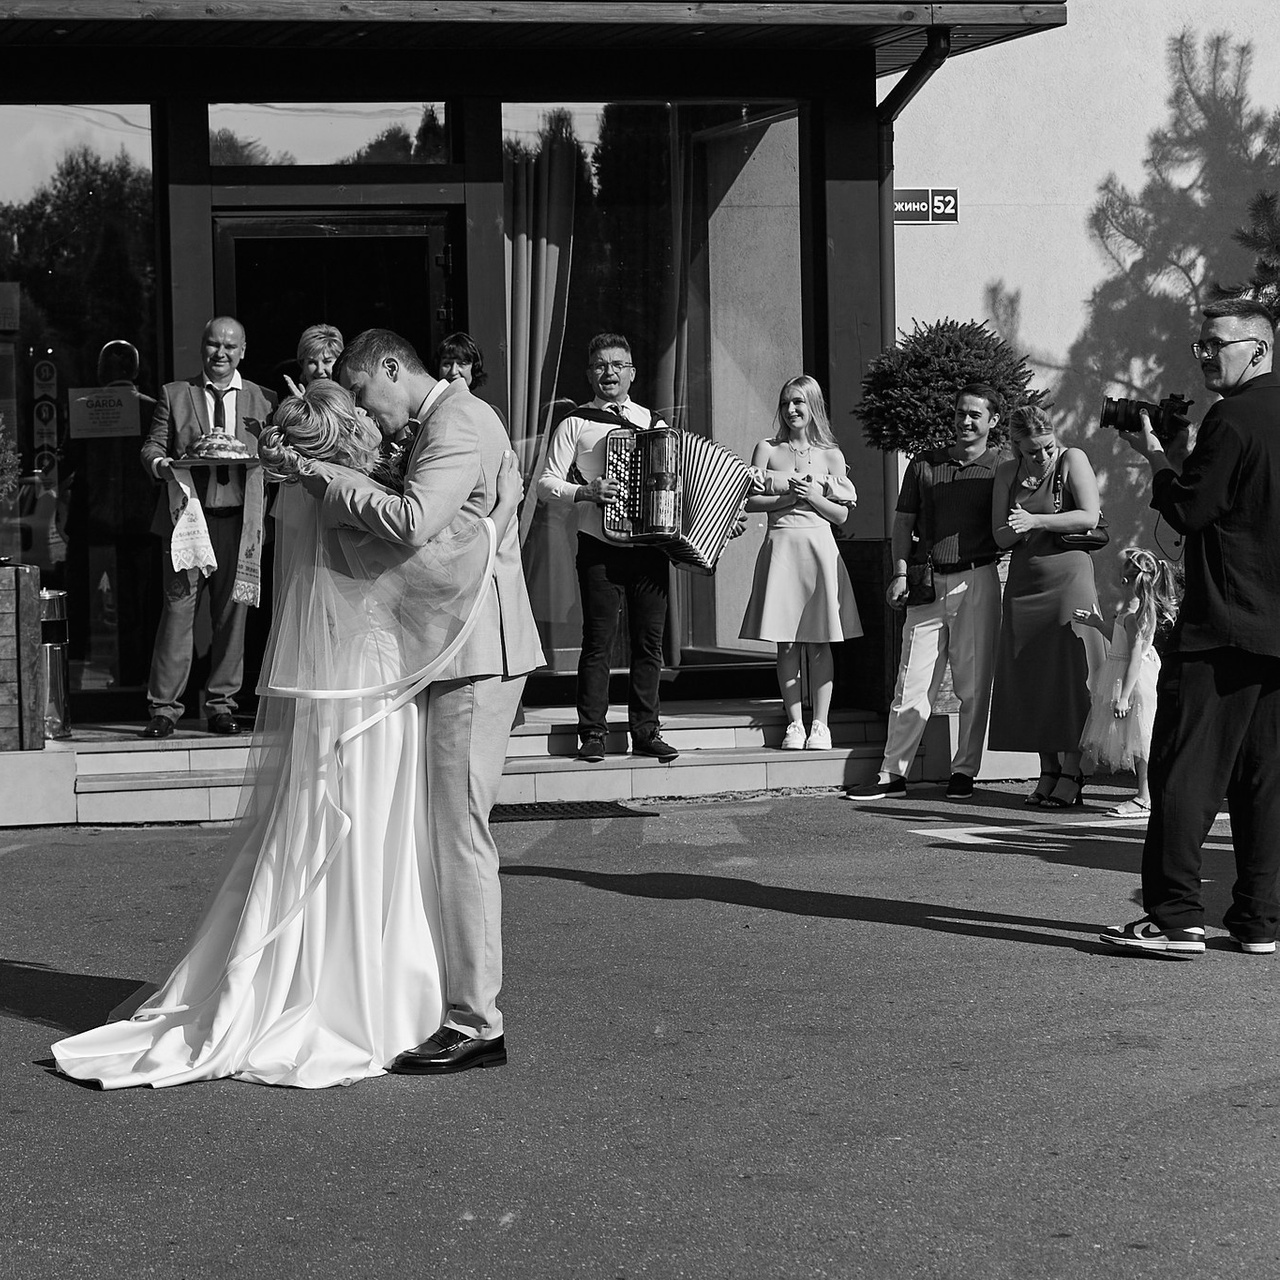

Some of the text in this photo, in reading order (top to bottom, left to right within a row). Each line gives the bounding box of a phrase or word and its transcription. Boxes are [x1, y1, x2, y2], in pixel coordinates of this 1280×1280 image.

[894, 195, 956, 214] жино 52
[85, 399, 123, 409] GARDA
